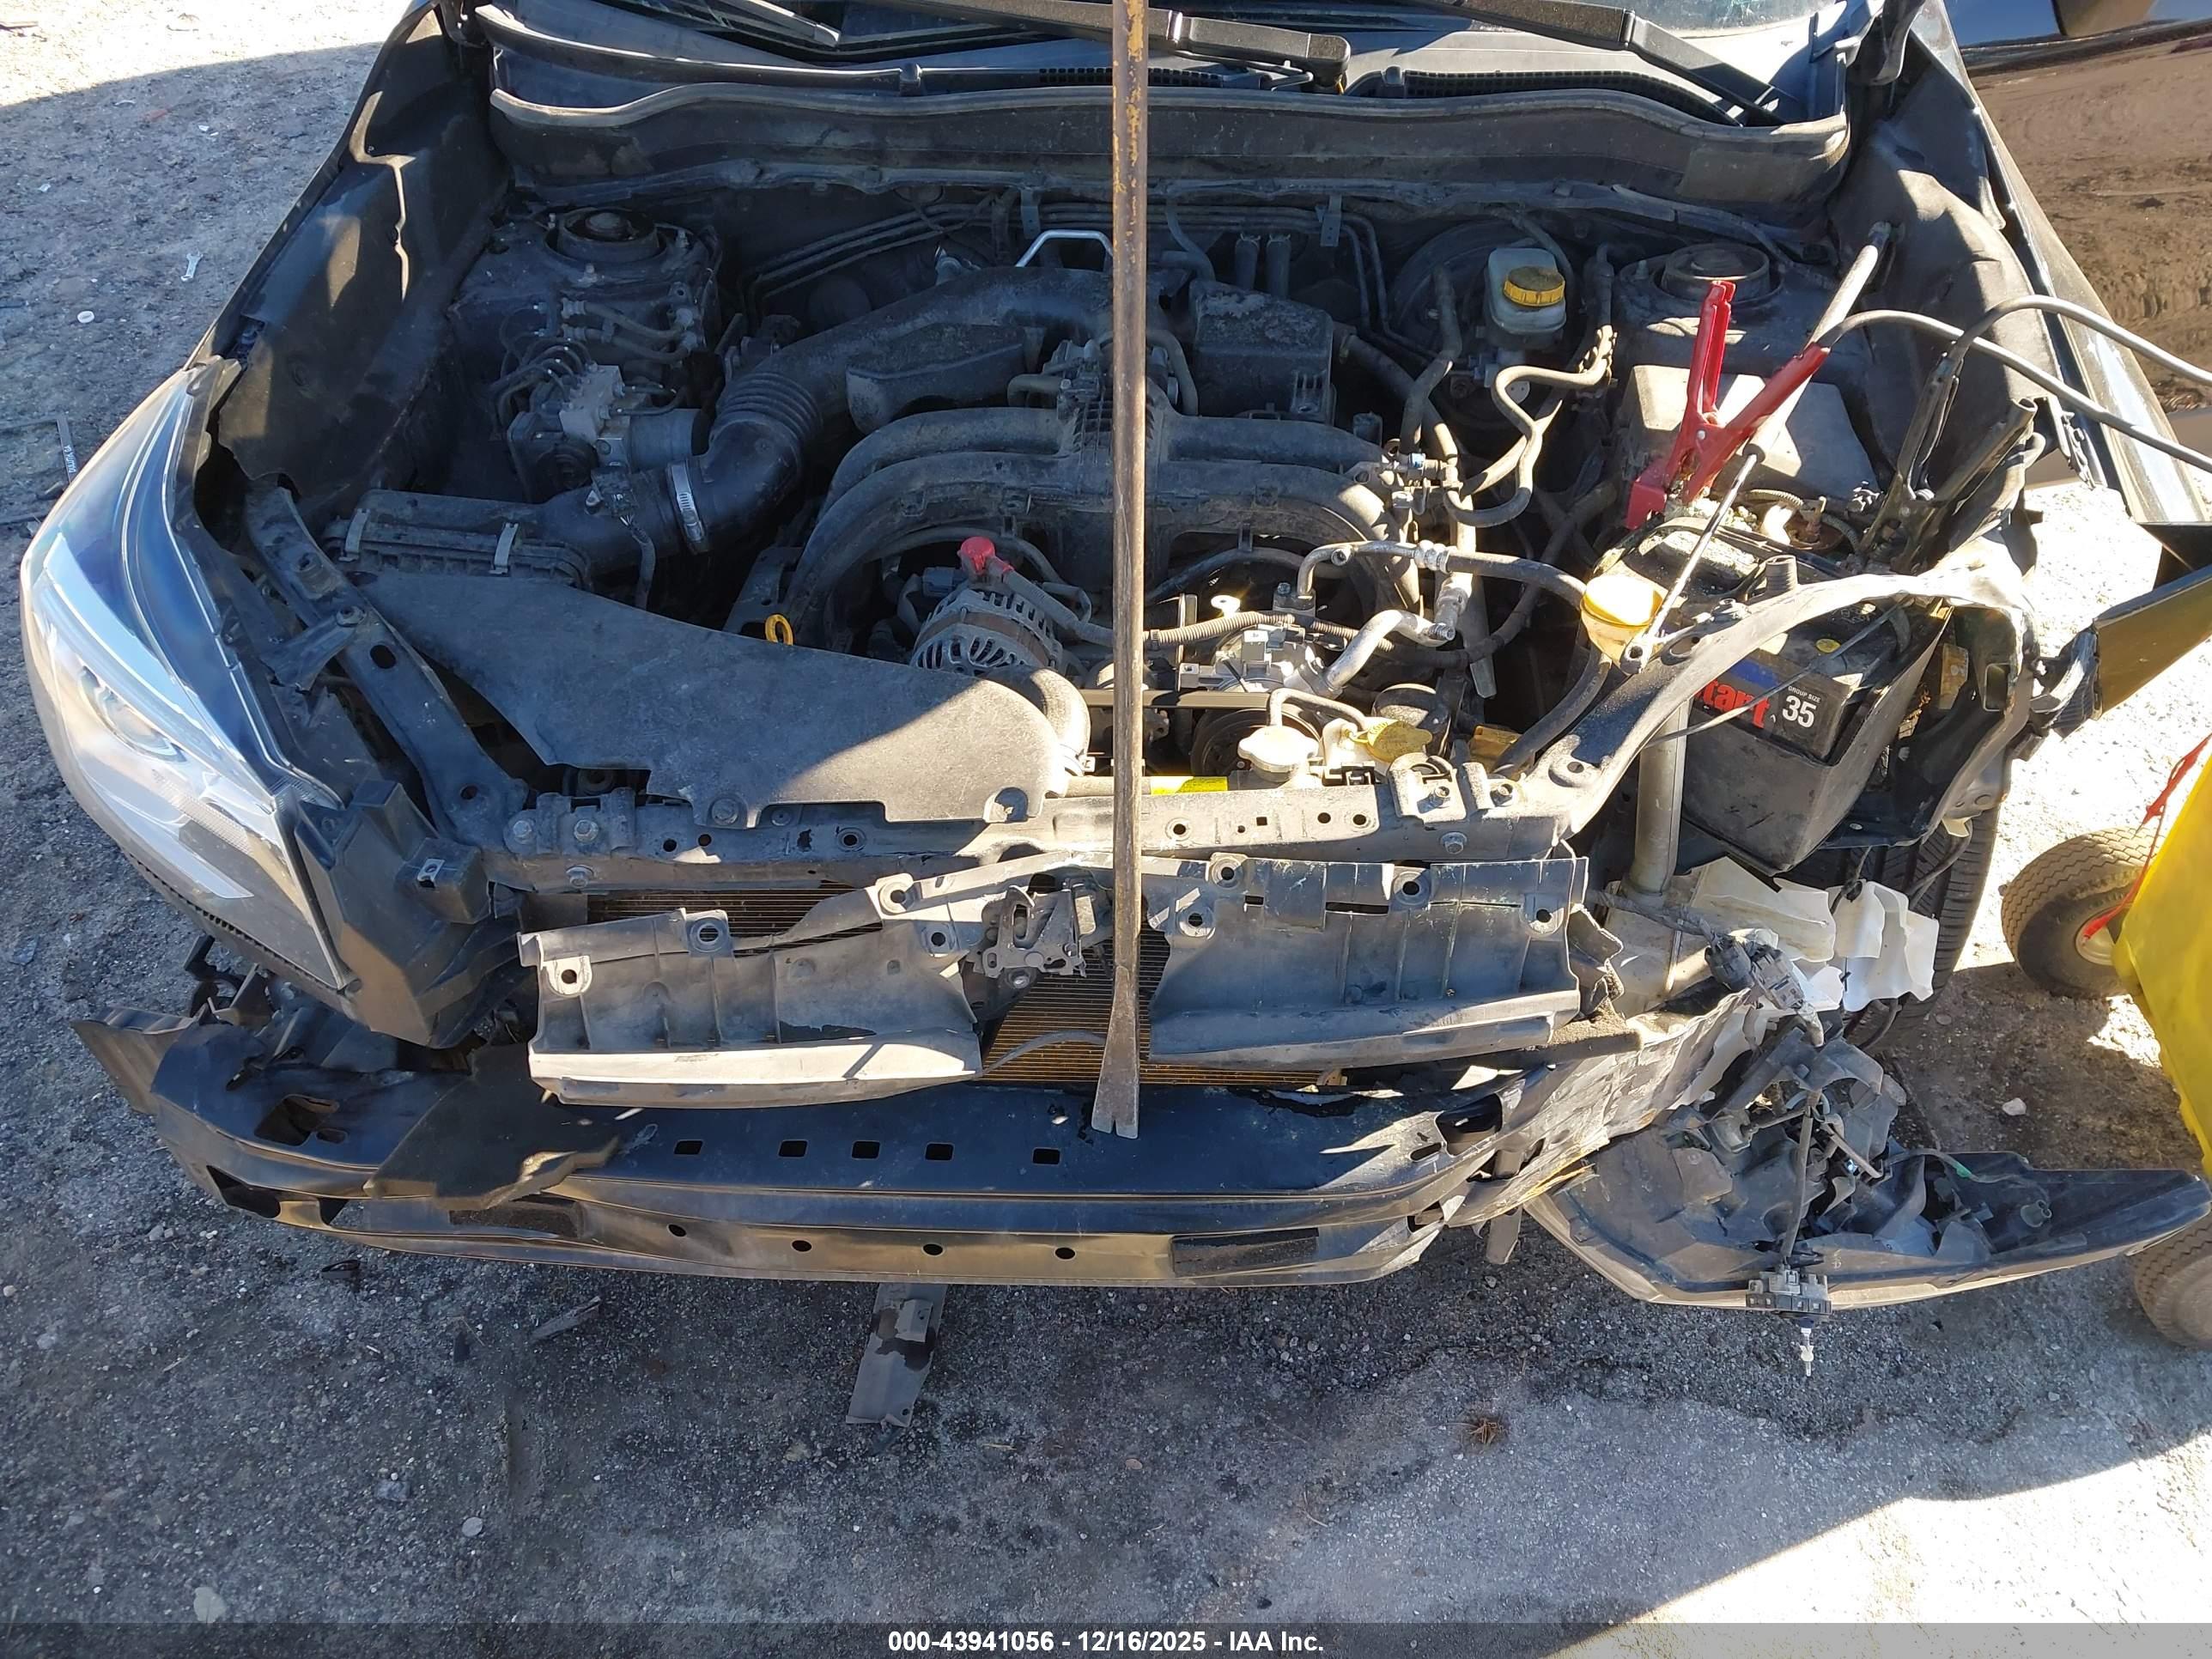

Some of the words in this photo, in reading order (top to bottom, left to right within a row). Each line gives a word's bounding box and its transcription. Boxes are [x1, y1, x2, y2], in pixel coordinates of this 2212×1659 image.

[1693, 678, 1771, 729] tart
[1788, 685, 1808, 697] GROUP
[1808, 693, 1821, 703] SIZE
[1782, 695, 1817, 728] 35
